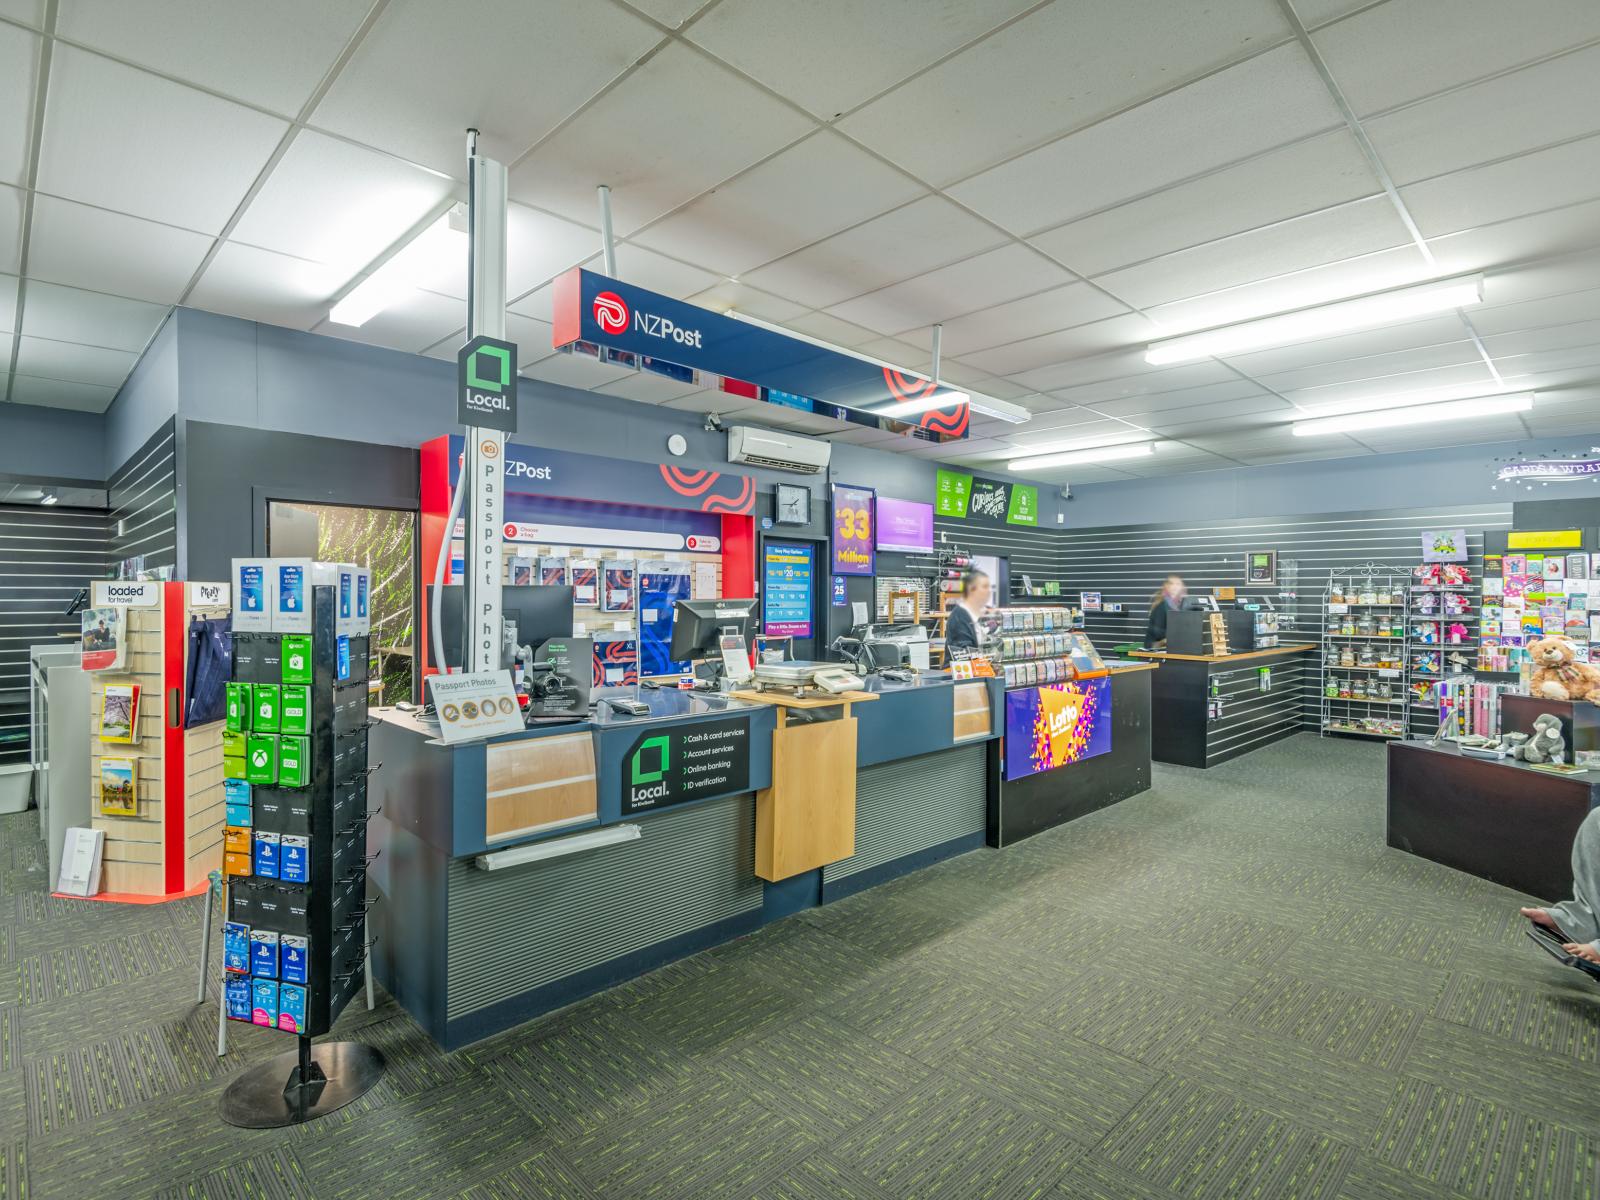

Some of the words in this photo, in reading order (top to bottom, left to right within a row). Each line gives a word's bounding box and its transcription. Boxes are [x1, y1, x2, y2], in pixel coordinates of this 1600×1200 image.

[634, 310, 702, 349] NZPost
[466, 388, 510, 411] Local.
[505, 460, 552, 480] ZPost
[1503, 464, 1545, 475] CARDS
[838, 547, 869, 564] Million
[108, 585, 144, 596] loaded
[834, 586, 844, 595] 25
[482, 603, 493, 673] Photo
[435, 678, 470, 691] Passport
[471, 677, 496, 688] Photos
[1049, 705, 1078, 731] Lotto
[688, 734, 703, 743] Cash
[703, 733, 709, 741] &
[709, 731, 722, 740] card
[723, 729, 744, 738] services
[688, 748, 711, 758] Account
[711, 745, 734, 754] services
[688, 765, 707, 774] Online
[707, 760, 731, 771] banking
[687, 781, 694, 789] ID
[695, 776, 727, 788] verification
[631, 781, 670, 802] Local.
